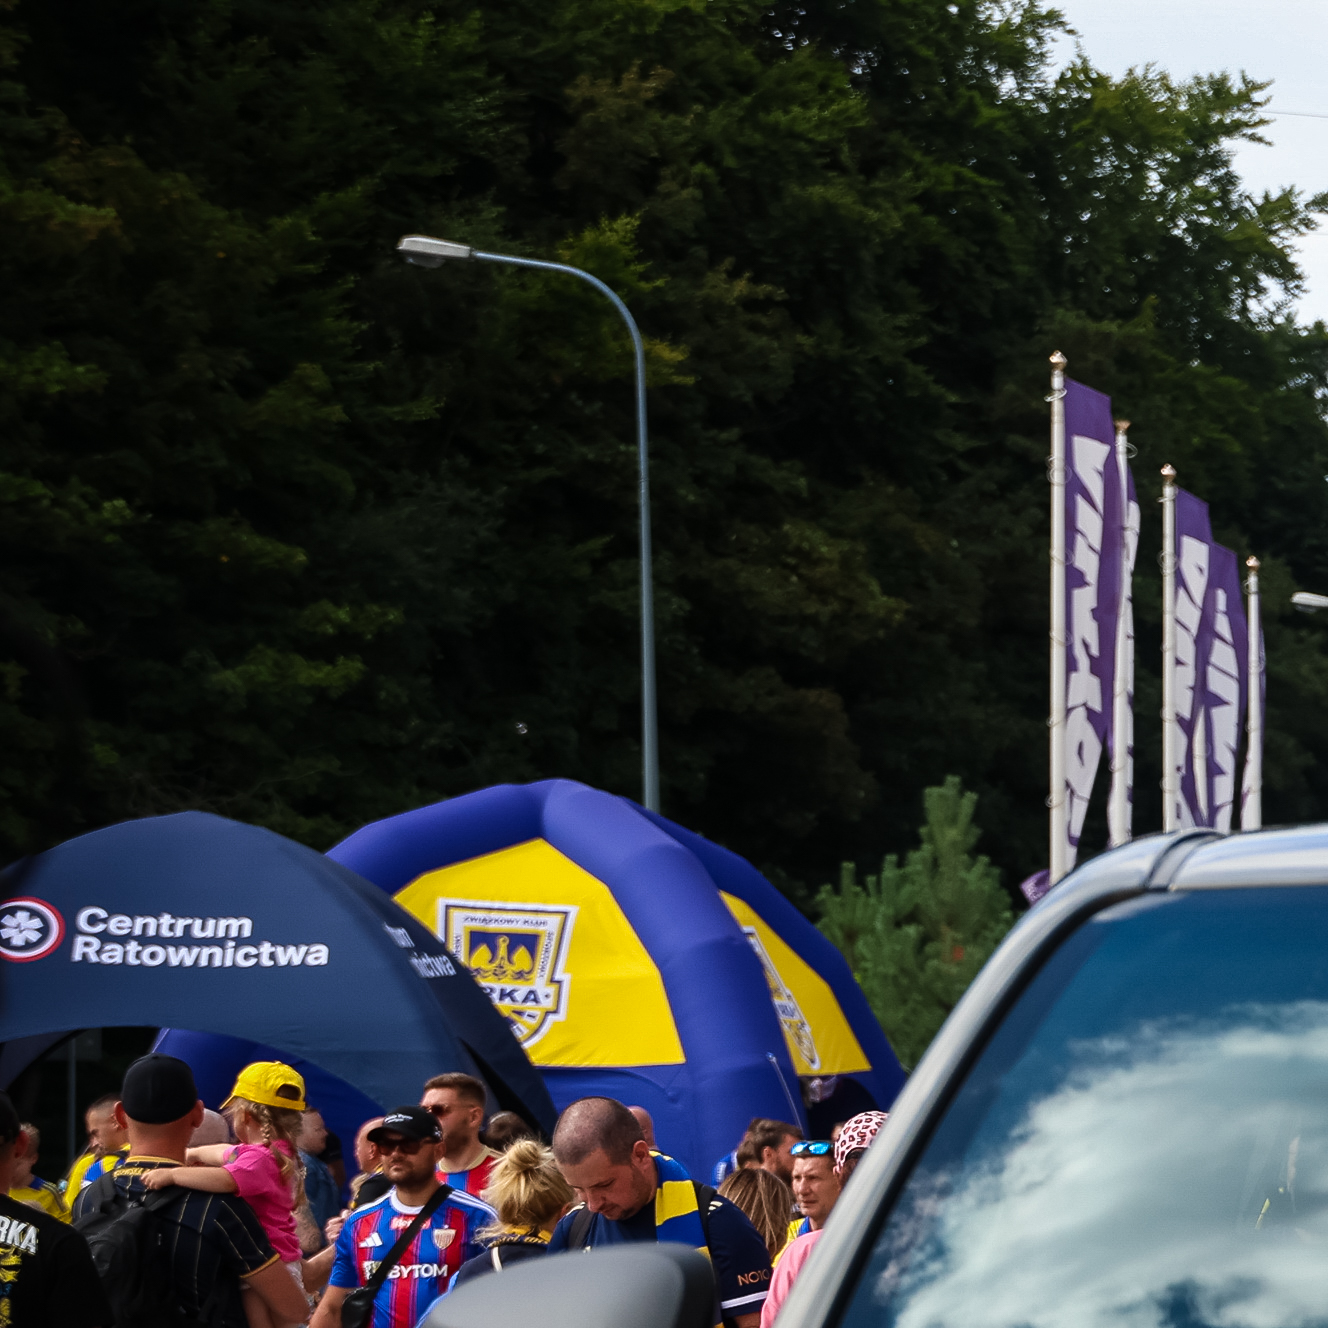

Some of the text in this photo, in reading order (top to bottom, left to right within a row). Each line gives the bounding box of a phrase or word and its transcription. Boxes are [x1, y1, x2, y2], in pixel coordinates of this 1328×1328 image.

[76, 906, 252, 939] Centrum
[71, 934, 330, 968] Ratownictwa
[0, 1215, 38, 1255] RKA
[388, 1263, 449, 1279] BYTOM
